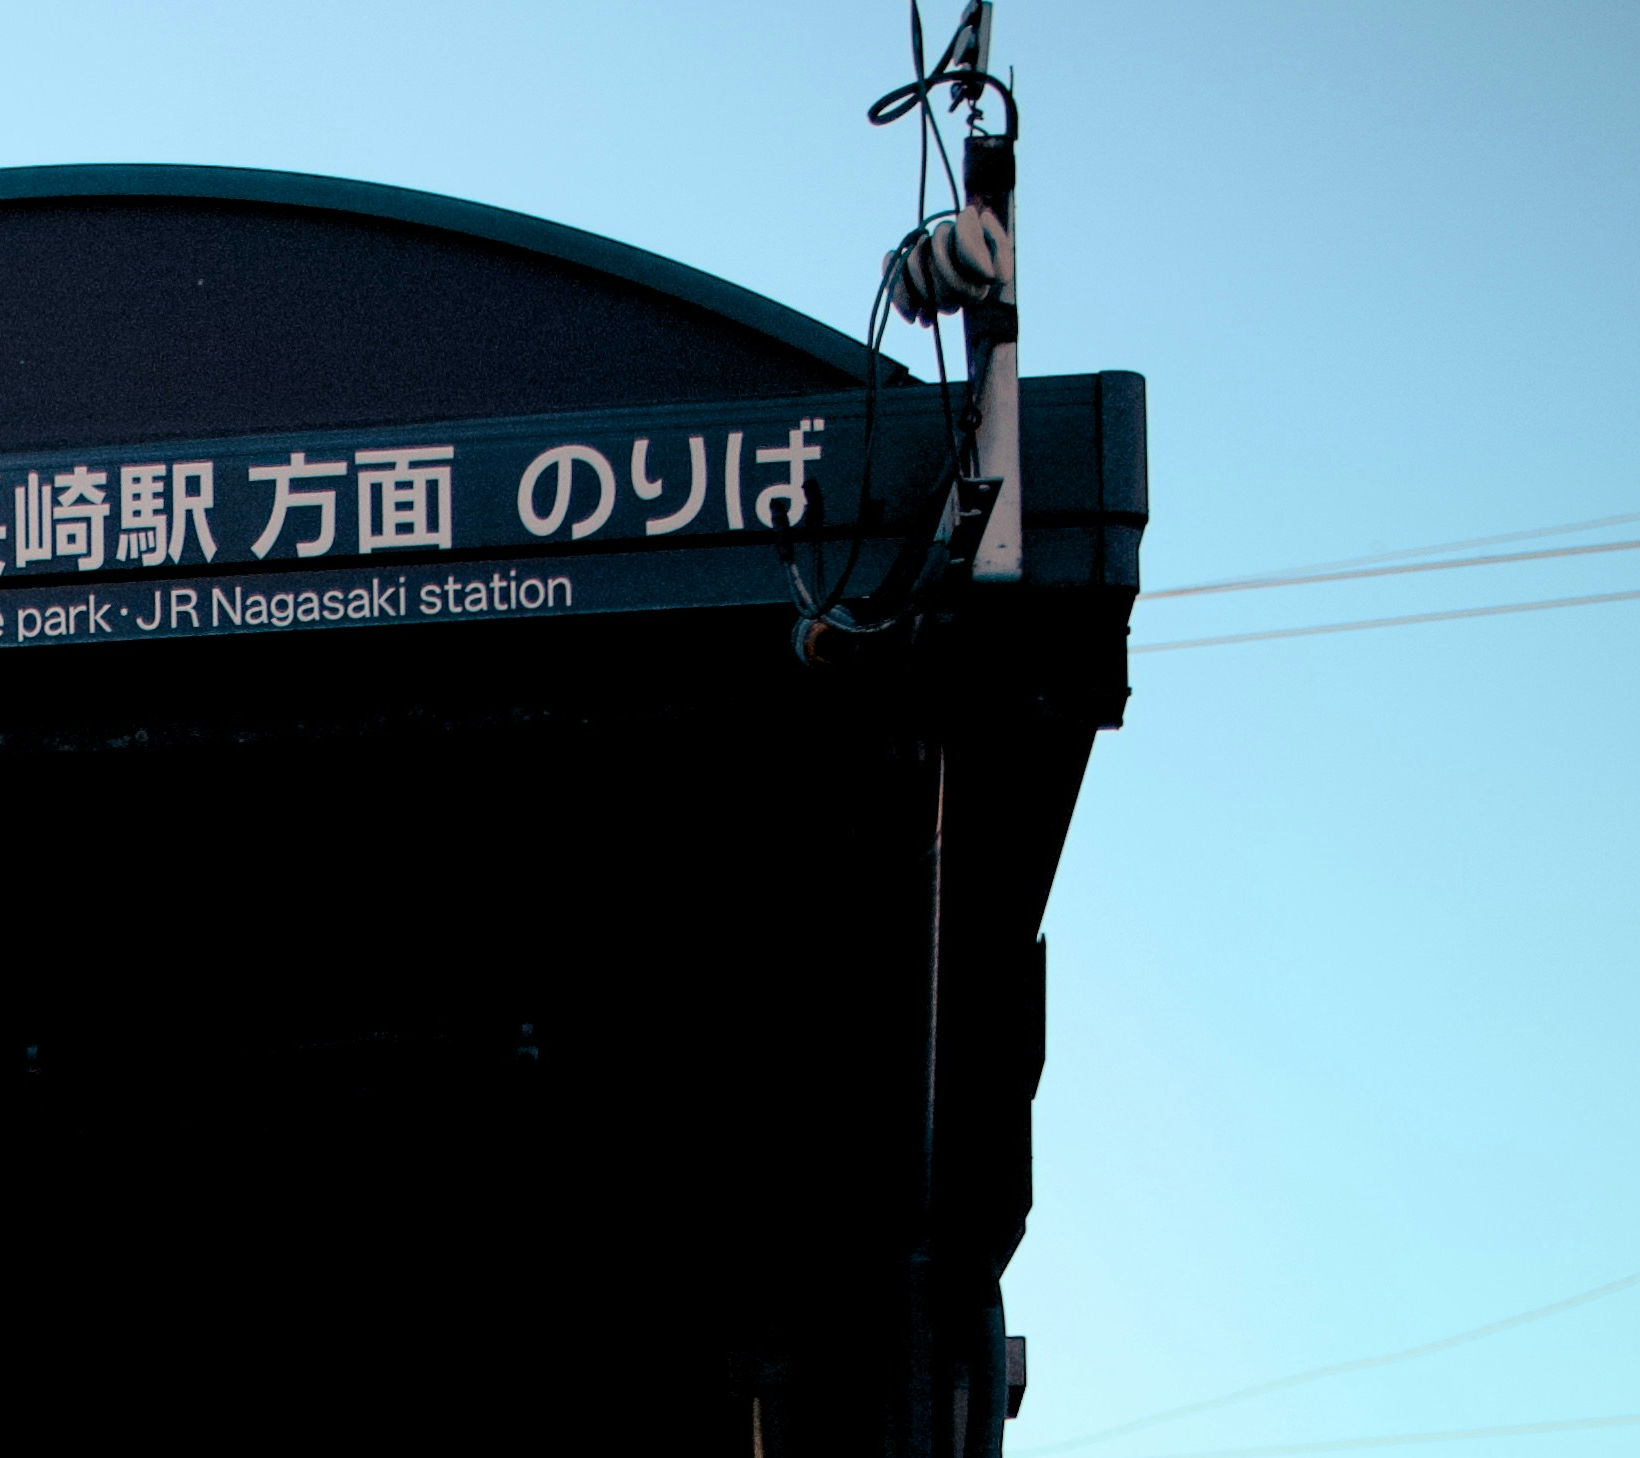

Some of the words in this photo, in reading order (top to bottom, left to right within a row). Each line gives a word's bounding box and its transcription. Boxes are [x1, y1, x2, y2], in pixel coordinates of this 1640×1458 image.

[247, 444, 456, 560] 方面
[516, 416, 826, 541] のりば
[209, 576, 408, 631] Nagasaki
[418, 568, 574, 615] station
